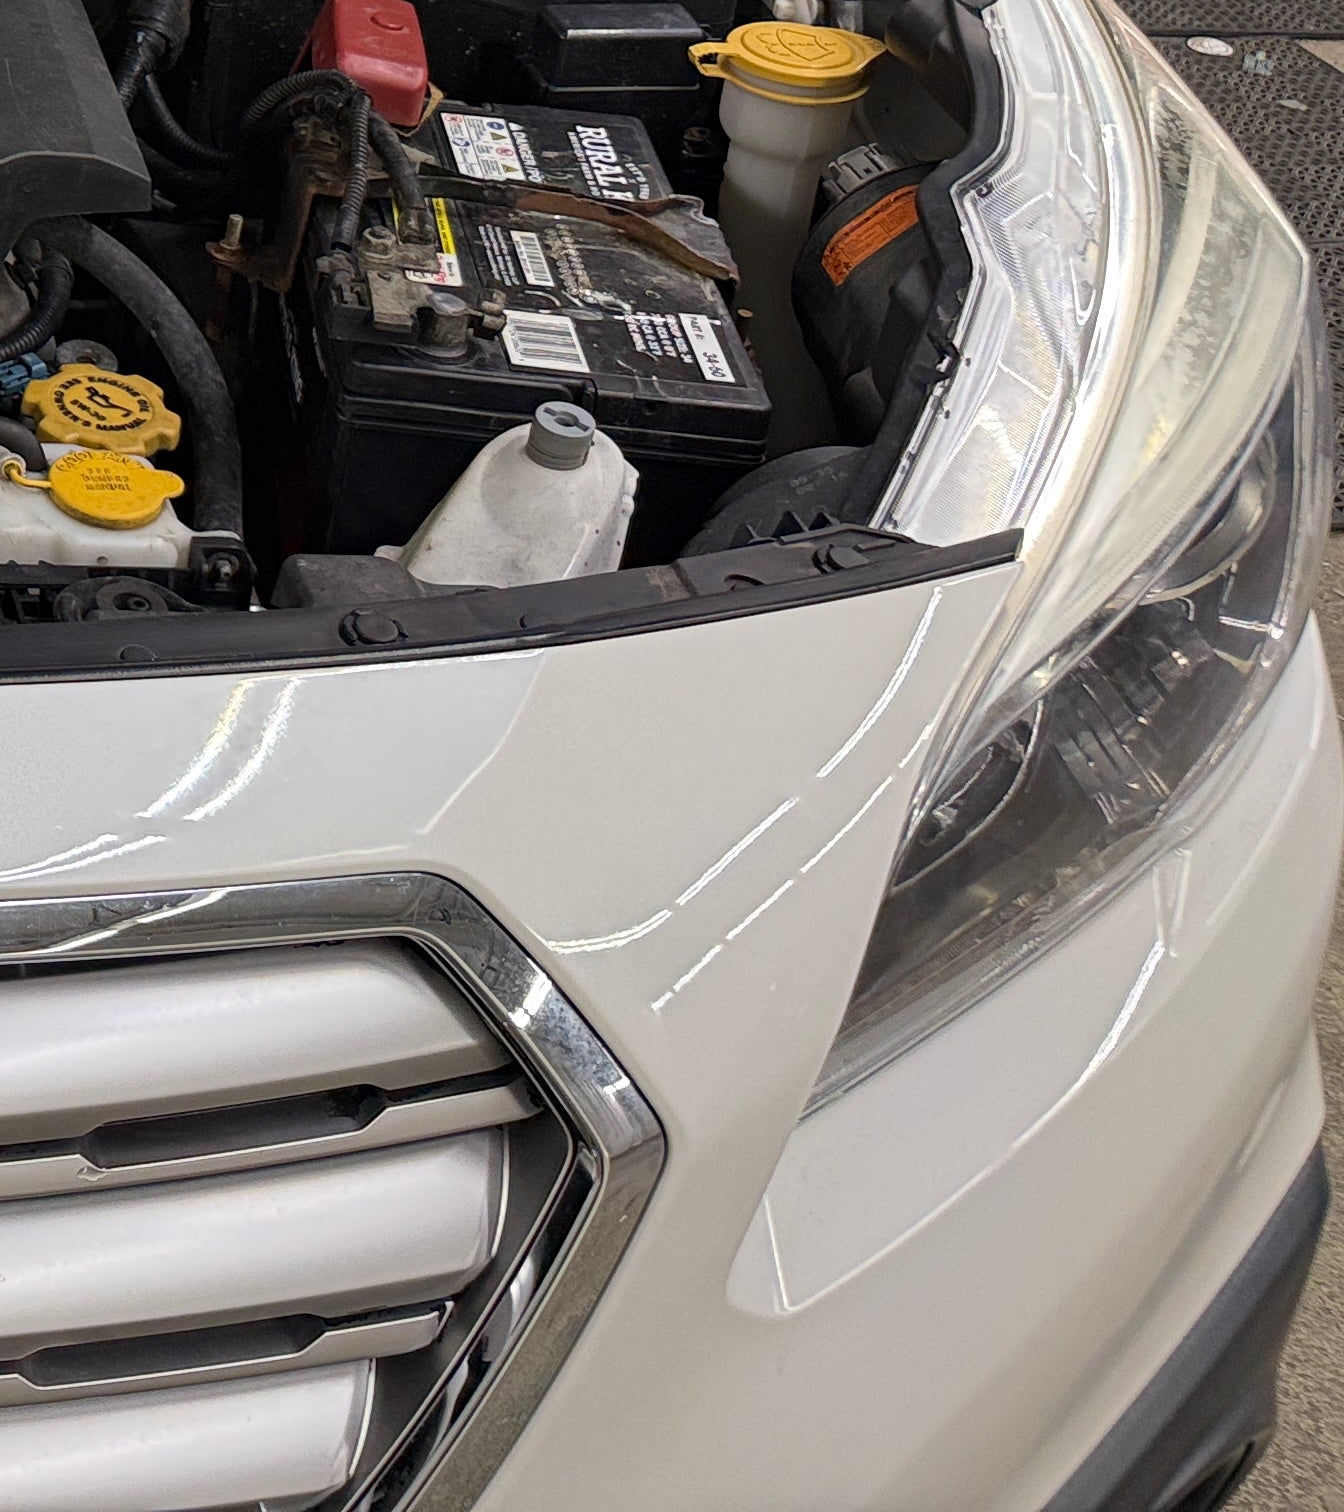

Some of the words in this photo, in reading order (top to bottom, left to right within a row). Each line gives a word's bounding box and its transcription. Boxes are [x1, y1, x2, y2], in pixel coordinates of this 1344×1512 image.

[575, 125, 628, 187] RURAL
[601, 188, 635, 202] K
[87, 376, 141, 398] ENGINE
[95, 417, 147, 431] MANUAL
